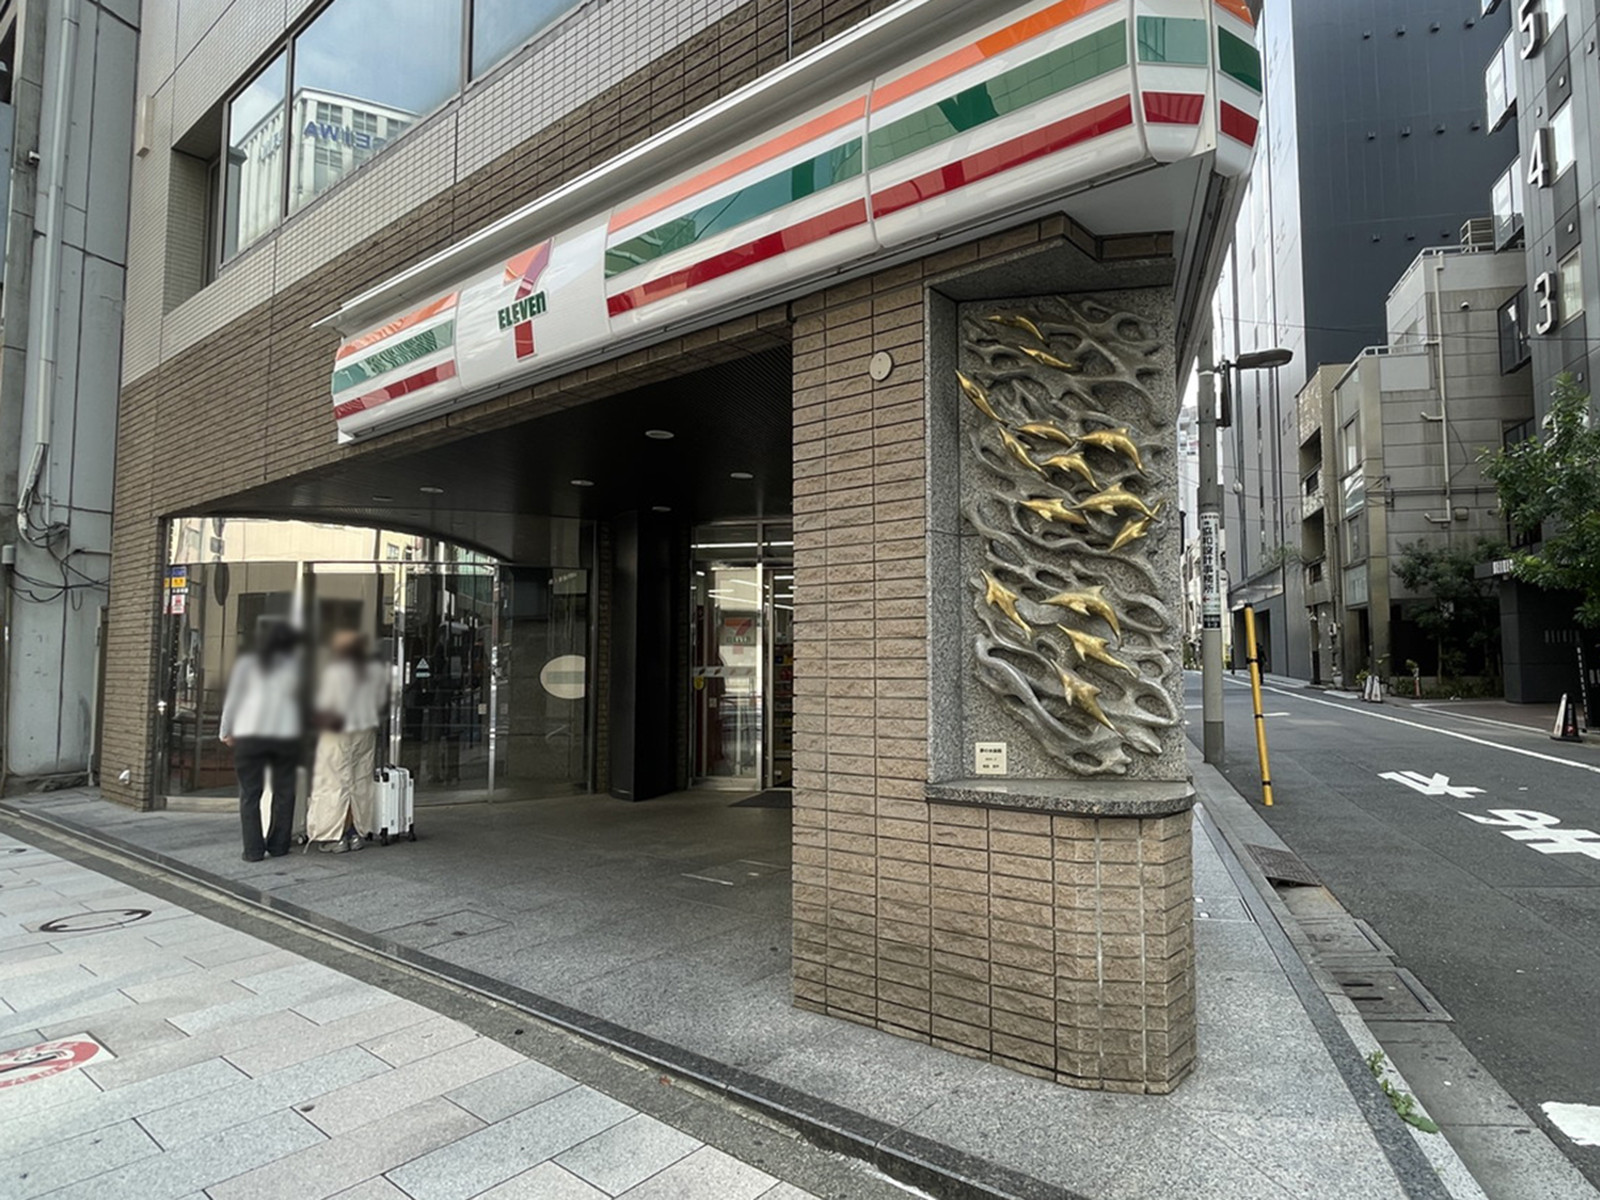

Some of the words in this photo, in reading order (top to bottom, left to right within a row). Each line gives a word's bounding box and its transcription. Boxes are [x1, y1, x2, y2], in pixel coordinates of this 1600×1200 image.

[1518, 0, 1547, 60] 5
[1527, 127, 1549, 189] 4
[503, 237, 554, 359] 7
[1533, 271, 1555, 335] 3
